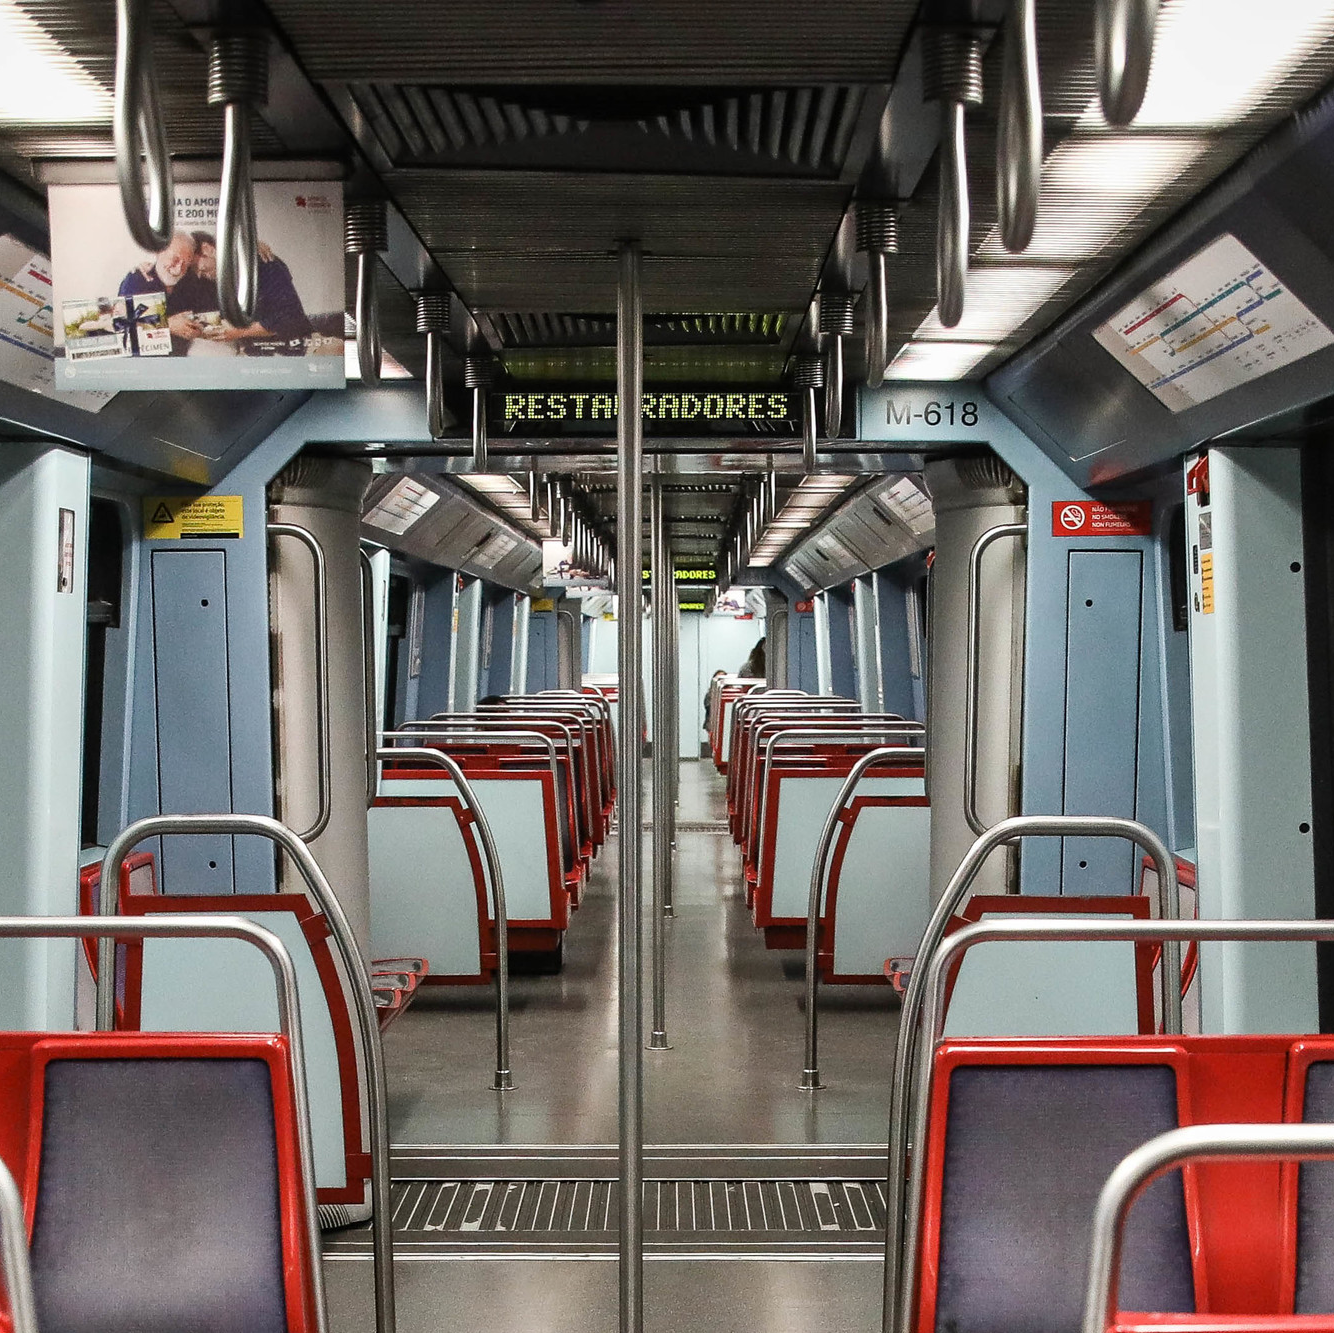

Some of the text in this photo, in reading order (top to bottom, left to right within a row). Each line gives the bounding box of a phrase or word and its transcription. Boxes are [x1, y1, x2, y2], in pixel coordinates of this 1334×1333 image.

[186, 209, 205, 218] 200
[505, 395, 787, 419] RESTARADORES
[886, 401, 979, 426] M-618
